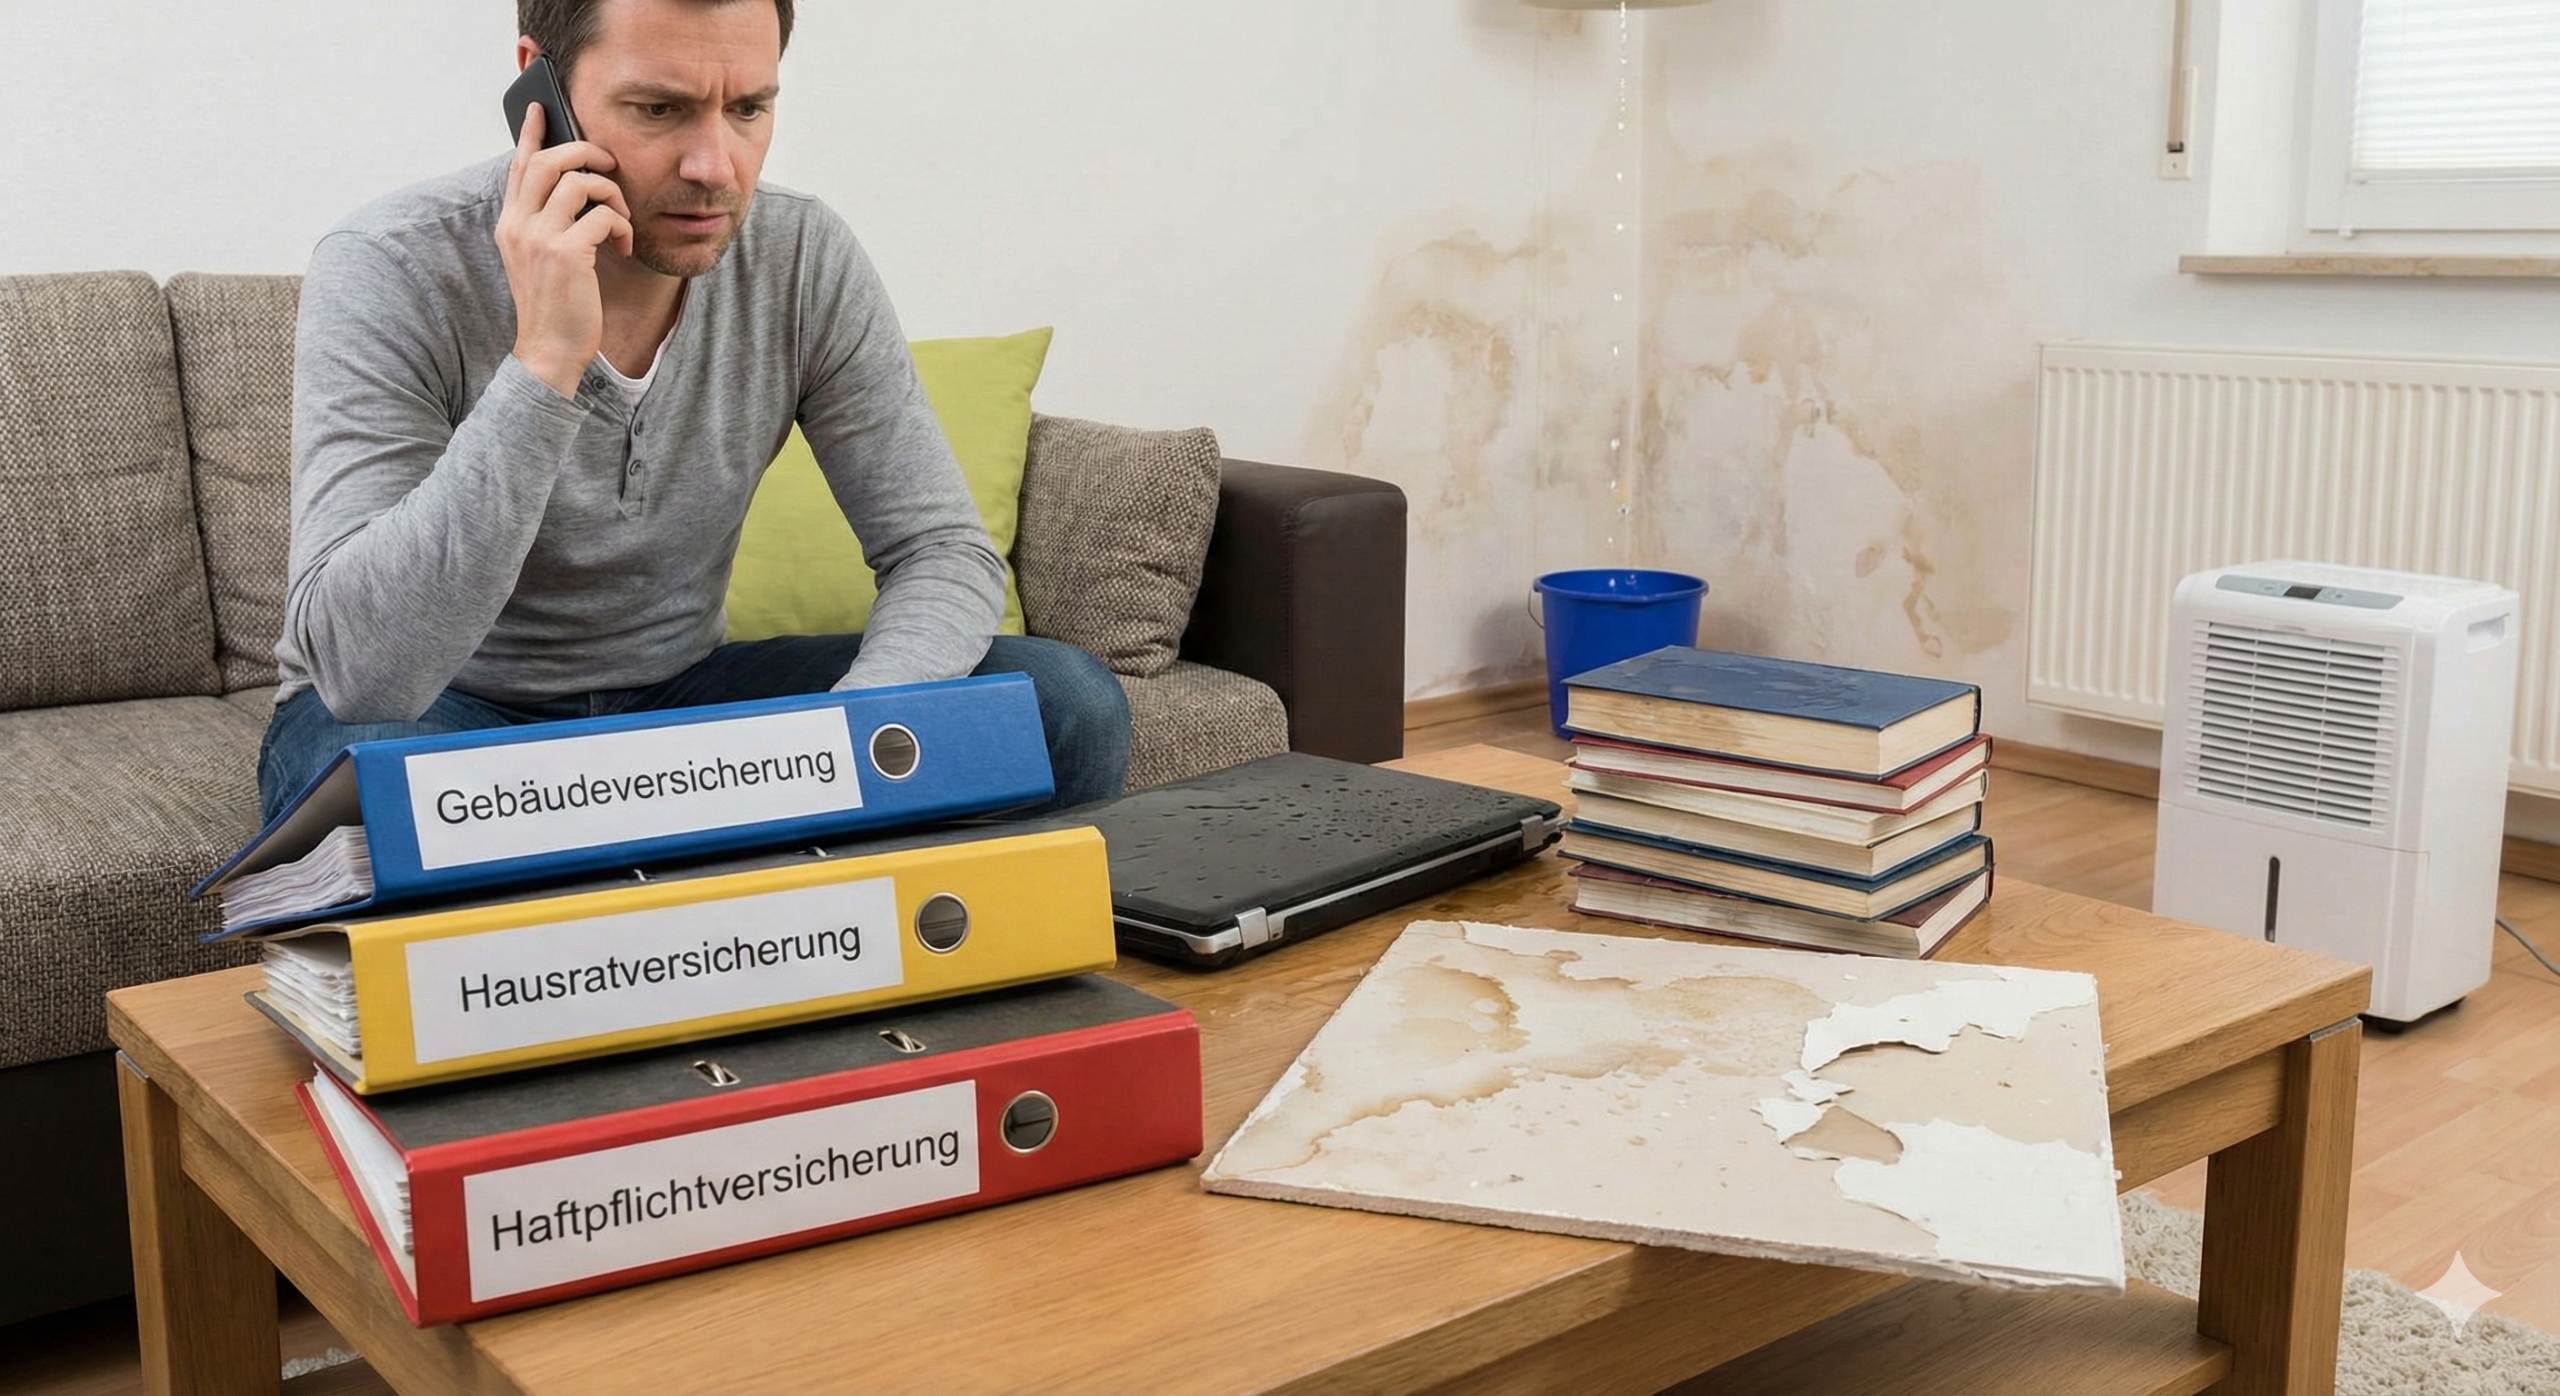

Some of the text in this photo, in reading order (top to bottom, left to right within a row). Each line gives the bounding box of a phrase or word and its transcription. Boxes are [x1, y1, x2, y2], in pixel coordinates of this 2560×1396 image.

[436, 751, 836, 825] Gebäudeversicherung
[460, 926, 861, 1013] Hausratversicherung
[491, 1130, 959, 1252] Haftpflichtversicherung
